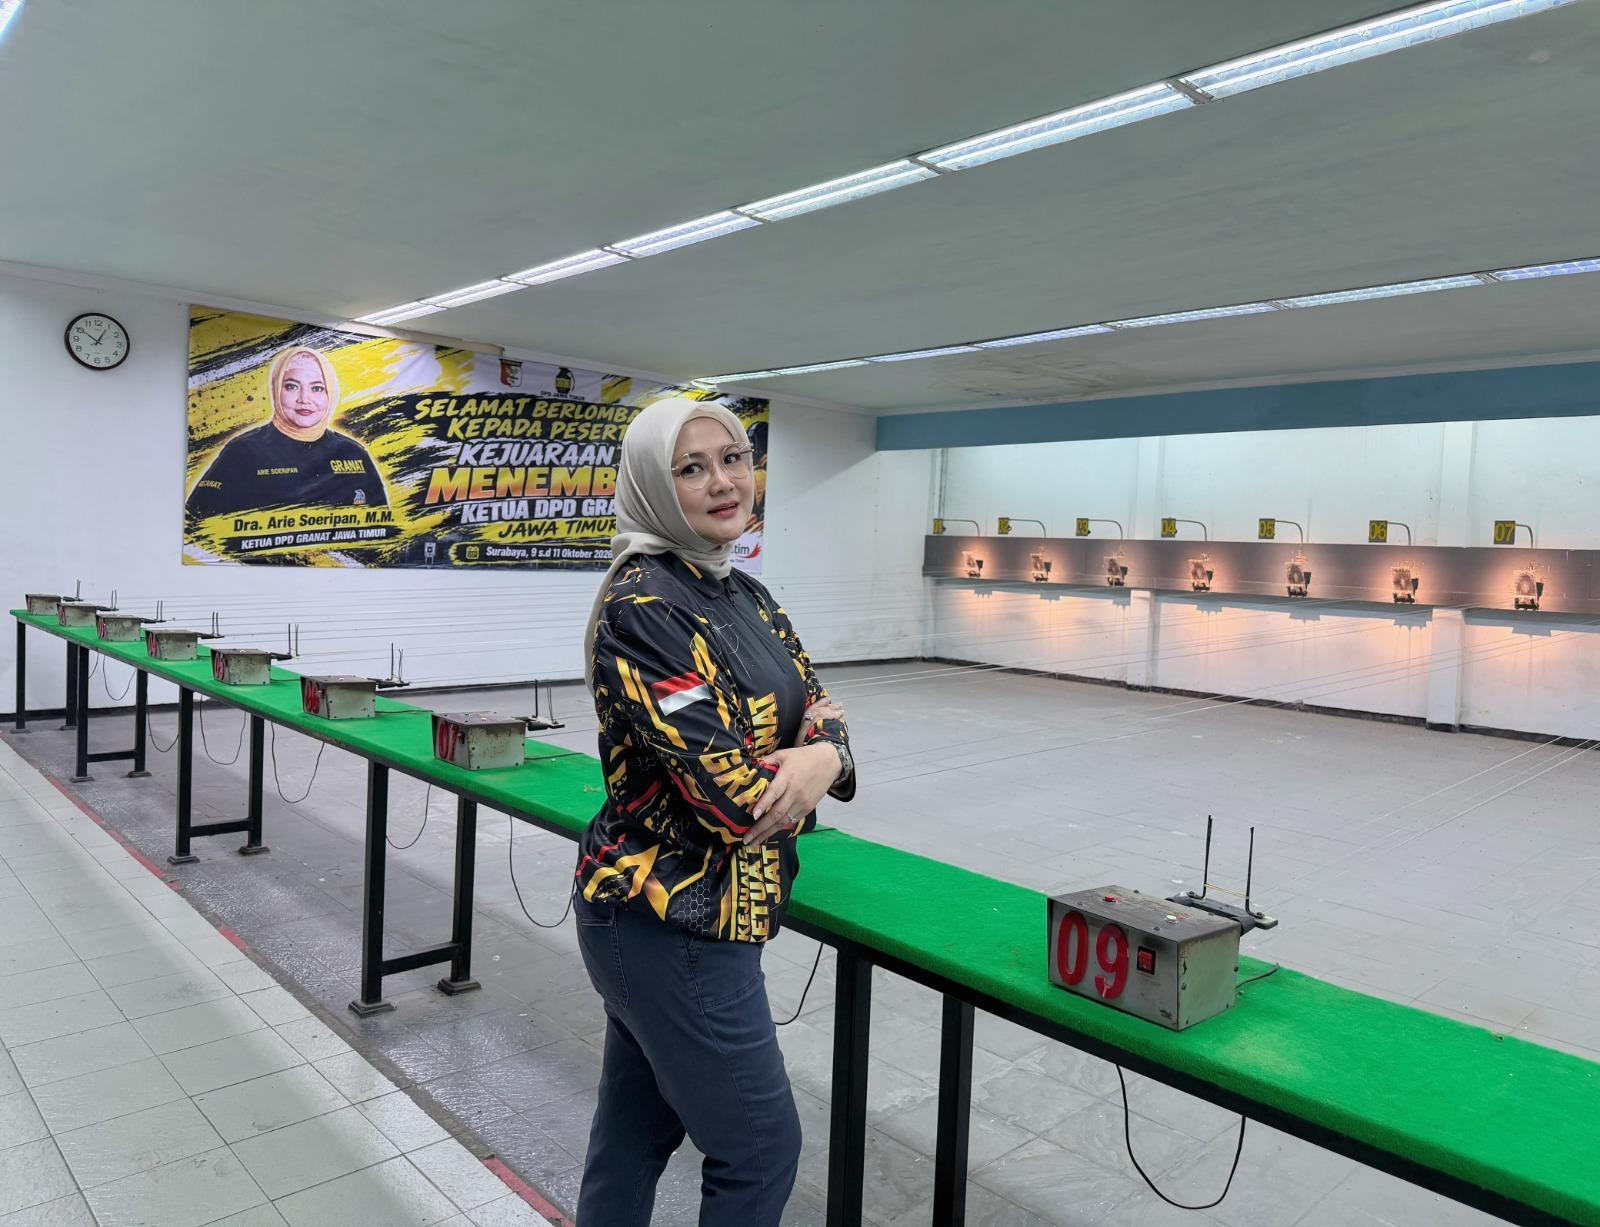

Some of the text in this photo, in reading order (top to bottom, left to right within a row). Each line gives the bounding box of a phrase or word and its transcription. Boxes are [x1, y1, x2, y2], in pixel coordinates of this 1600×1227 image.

[114, 331, 120, 339] 2
[415, 398, 530, 420] SELAMAT
[447, 418, 629, 442] KEPADA PESERT
[458, 442, 616, 467] KEJUARAAN
[330, 459, 366, 472] GRANAT
[425, 466, 617, 505] MENEMB
[233, 510, 395, 532] Dra. Arie Soeripan, M.M.
[461, 498, 617, 523] KETUA DPD GRA
[499, 518, 617, 538] JAWA TIMUR
[1162, 519, 1176, 536] 04
[1259, 520, 1275, 537] 05
[1369, 522, 1387, 540] 06
[1494, 523, 1516, 542] 07
[241, 528, 386, 550] KETUA DPD GRANAT JAWA TIMUR
[486, 546, 529, 559] Surabaya,
[531, 547, 537, 558] 9
[538, 548, 552, 558] s.d
[553, 549, 561, 558] 11
[561, 549, 593, 559] Oktober
[1056, 910, 1130, 1000] 09
